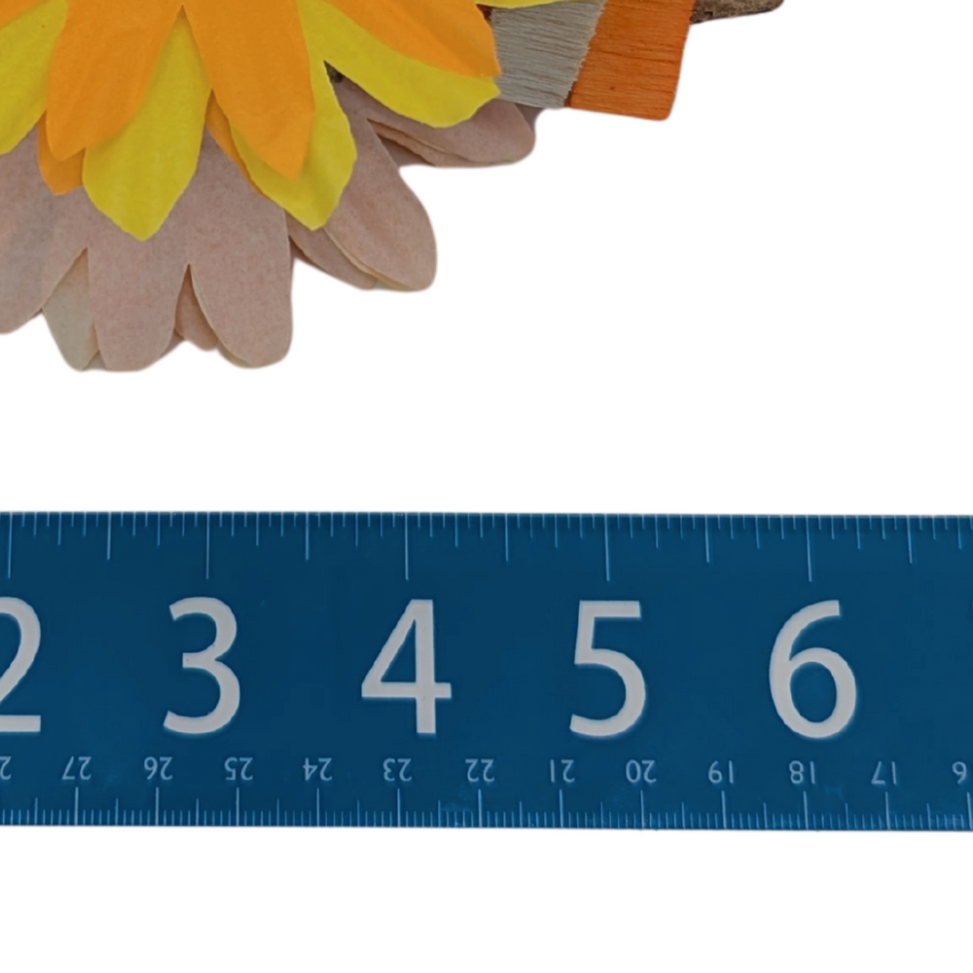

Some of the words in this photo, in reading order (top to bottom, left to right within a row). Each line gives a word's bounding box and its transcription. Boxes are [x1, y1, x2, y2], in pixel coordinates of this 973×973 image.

[163, 596, 241, 735] 3
[361, 599, 452, 734] 4
[569, 600, 647, 738] 5
[769, 600, 857, 739] 6
[62, 756, 91, 780] 27
[144, 756, 172, 780] 26
[224, 757, 253, 781] 25
[303, 758, 332, 781] 24
[383, 758, 411, 782] 23
[465, 759, 494, 783] 22
[550, 759, 575, 783] 21
[625, 760, 656, 784] 20
[708, 761, 734, 784] 19
[789, 760, 815, 784] 18
[871, 762, 897, 785] 17
